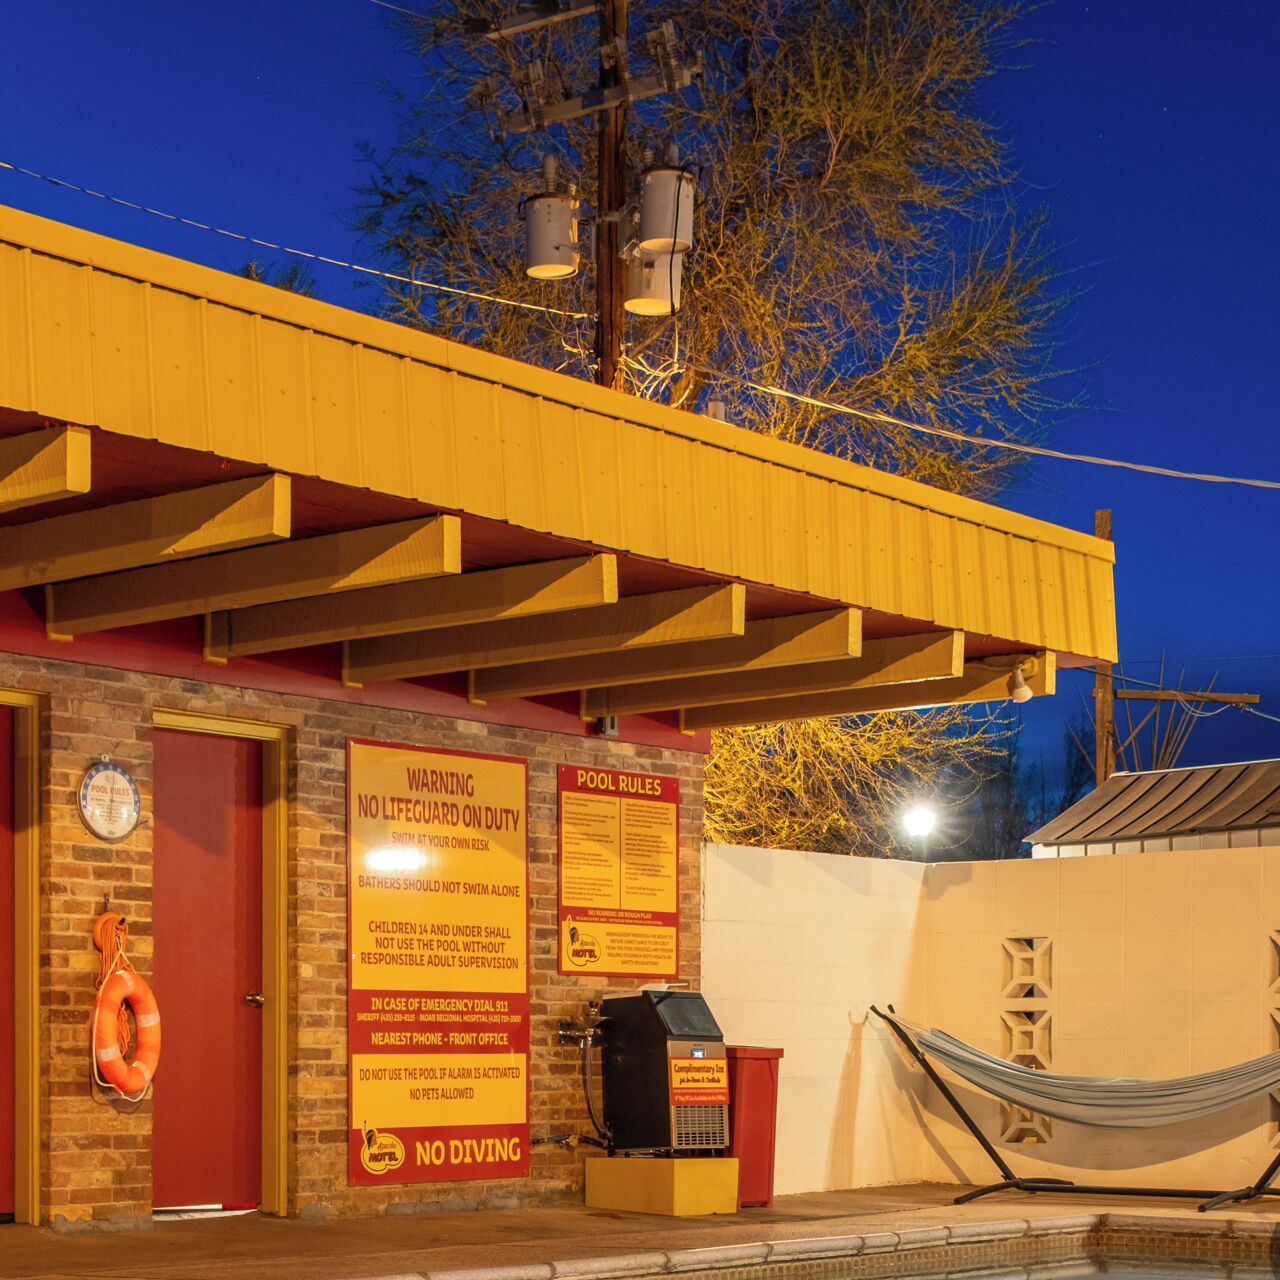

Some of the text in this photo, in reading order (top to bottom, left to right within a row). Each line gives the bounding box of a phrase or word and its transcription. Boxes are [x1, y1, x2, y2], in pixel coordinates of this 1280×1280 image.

[91, 785, 108, 794] POOL
[407, 767, 474, 797] WARNING
[577, 769, 662, 797] POOL RULES
[358, 794, 520, 832] NO LIFEGUARD ON DUTY
[392, 832, 490, 851] SWIM AT YOUR OWN RISK
[358, 875, 520, 897] BATHERS SHOULD NOT SWIM ALONE
[369, 921, 511, 939] CHILDREN 14 AND UNDER SHALL
[376, 937, 505, 954] NOT USE THE POOL WITHOUT
[361, 952, 519, 969] RESPONSIBLE ADULT SUPERVISION
[371, 998, 508, 1012] IN CASE OF EMERGENCY DIAL 911
[372, 1032, 508, 1045] NEAREST PHONE FRONT OFFICE
[360, 1067, 520, 1081] DO NOT USE THE POOL IF ALARM IS ACTIVATED
[410, 1087, 474, 1100] NO PETS ALLOWED
[416, 1137, 521, 1166] NO DIVING
